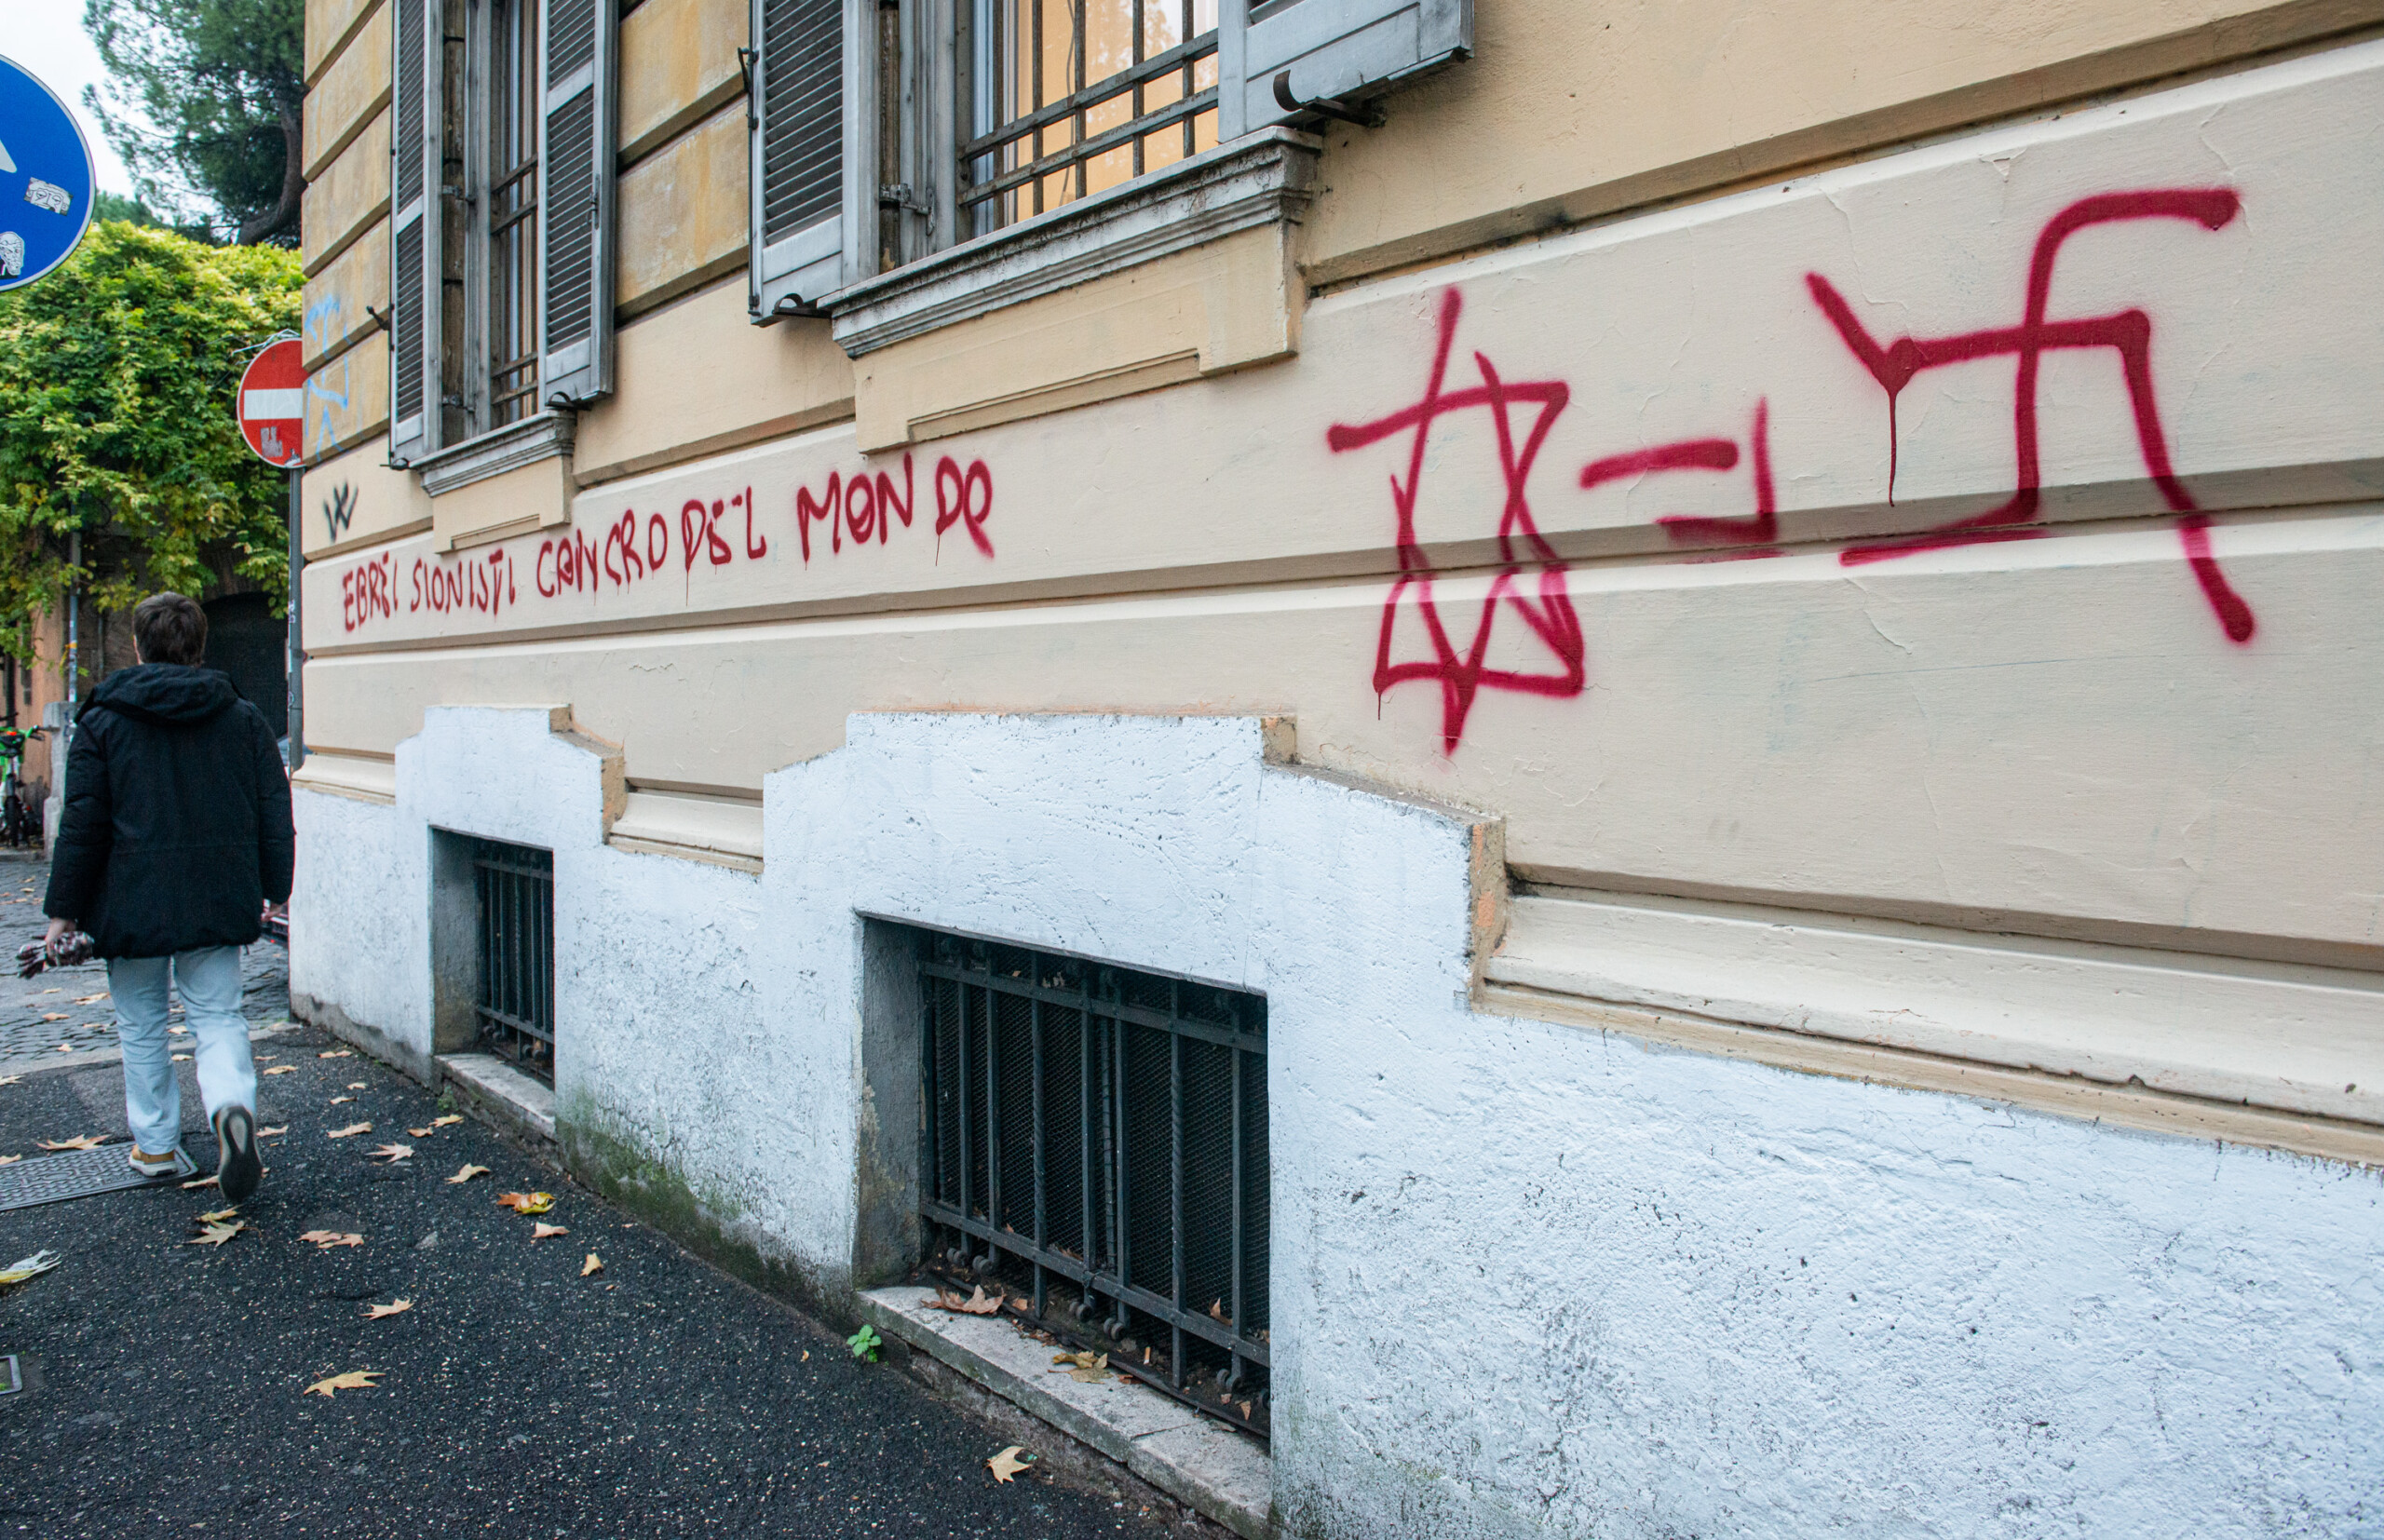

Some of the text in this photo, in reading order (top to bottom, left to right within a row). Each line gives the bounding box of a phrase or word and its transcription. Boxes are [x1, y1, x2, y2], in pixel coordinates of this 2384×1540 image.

[343, 551, 399, 632] EBREI
[411, 548, 516, 617] SIONISTI
[537, 508, 668, 600] CANCRO
[681, 485, 766, 581] DEL
